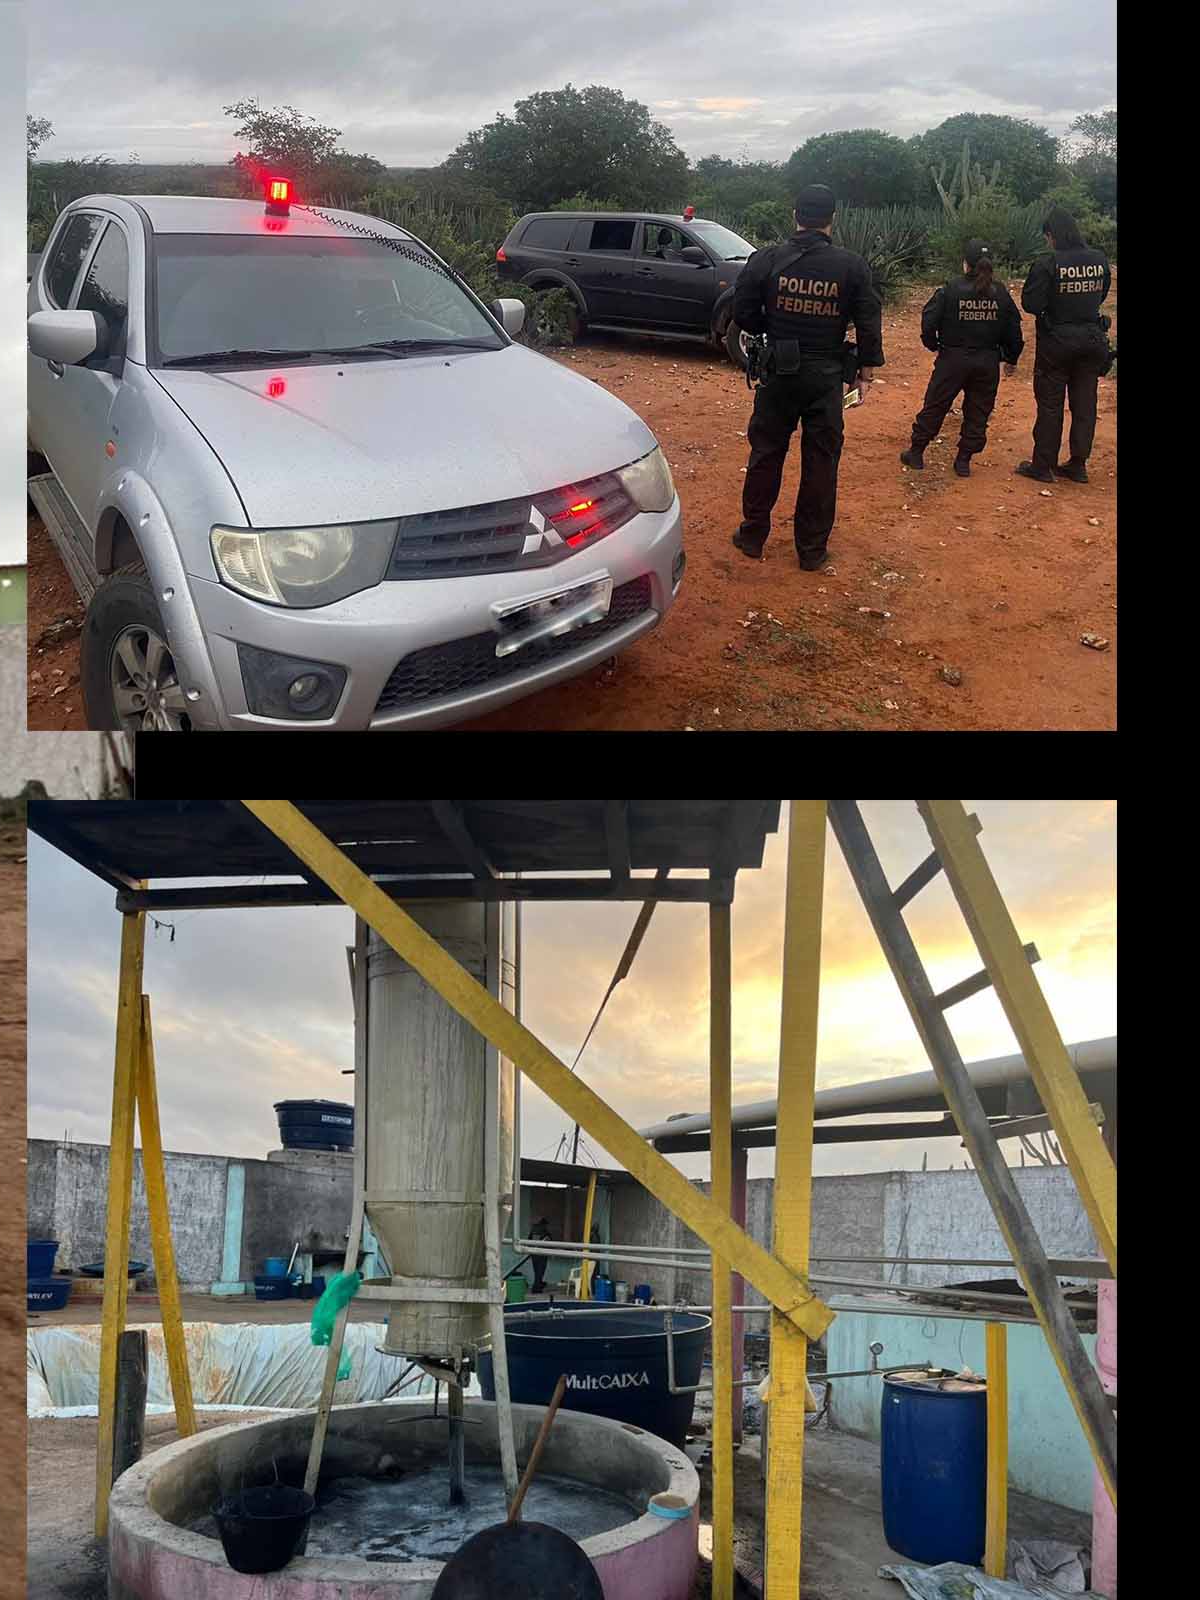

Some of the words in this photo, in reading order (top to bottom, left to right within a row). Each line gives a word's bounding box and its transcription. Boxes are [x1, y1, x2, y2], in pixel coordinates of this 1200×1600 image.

[1060, 264, 1104, 279] POLICIA
[778, 275, 839, 298] POLICIA
[776, 295, 841, 316] FEDERAL
[959, 299, 999, 310] POLICIA
[959, 311, 999, 321] FEDERAL
[562, 1371, 650, 1390] MultCAIXA
